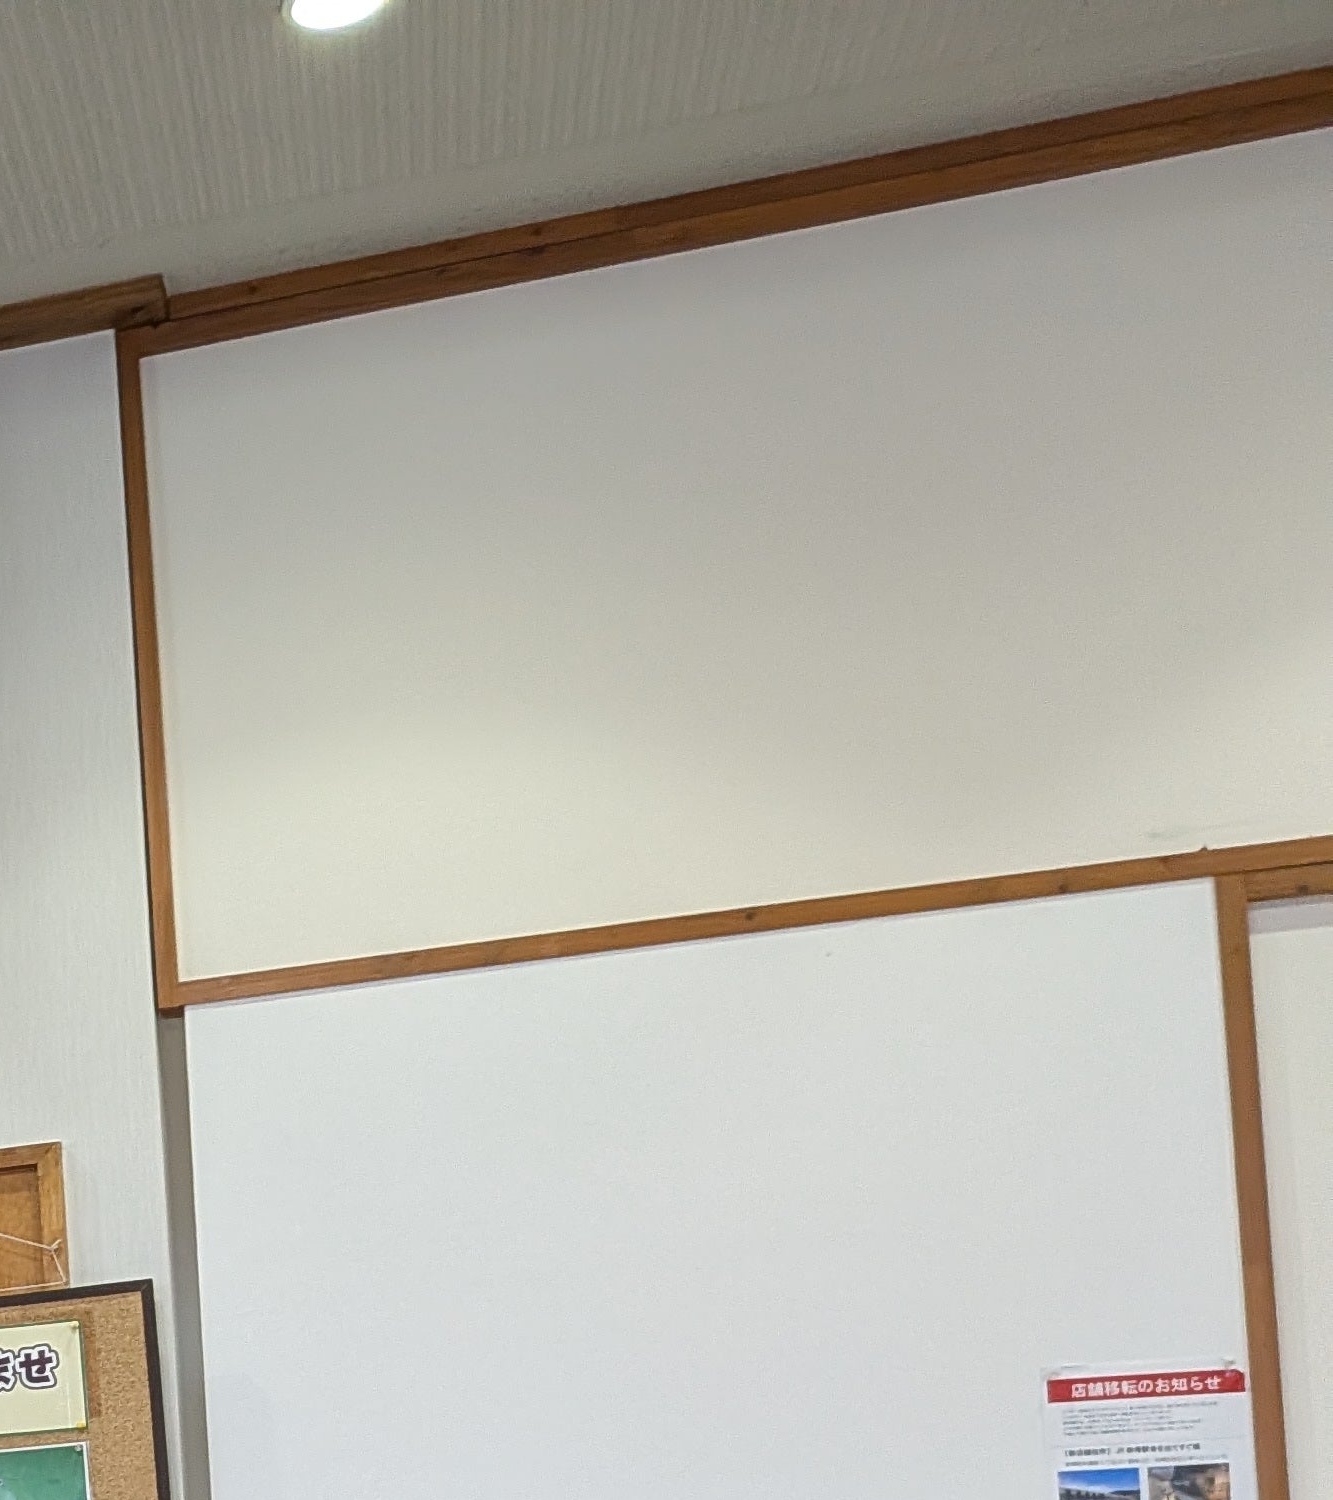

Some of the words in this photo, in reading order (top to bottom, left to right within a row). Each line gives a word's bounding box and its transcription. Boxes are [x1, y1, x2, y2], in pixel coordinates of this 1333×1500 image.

[1071, 1375, 1221, 1399] 店舗移転のお知らせ
